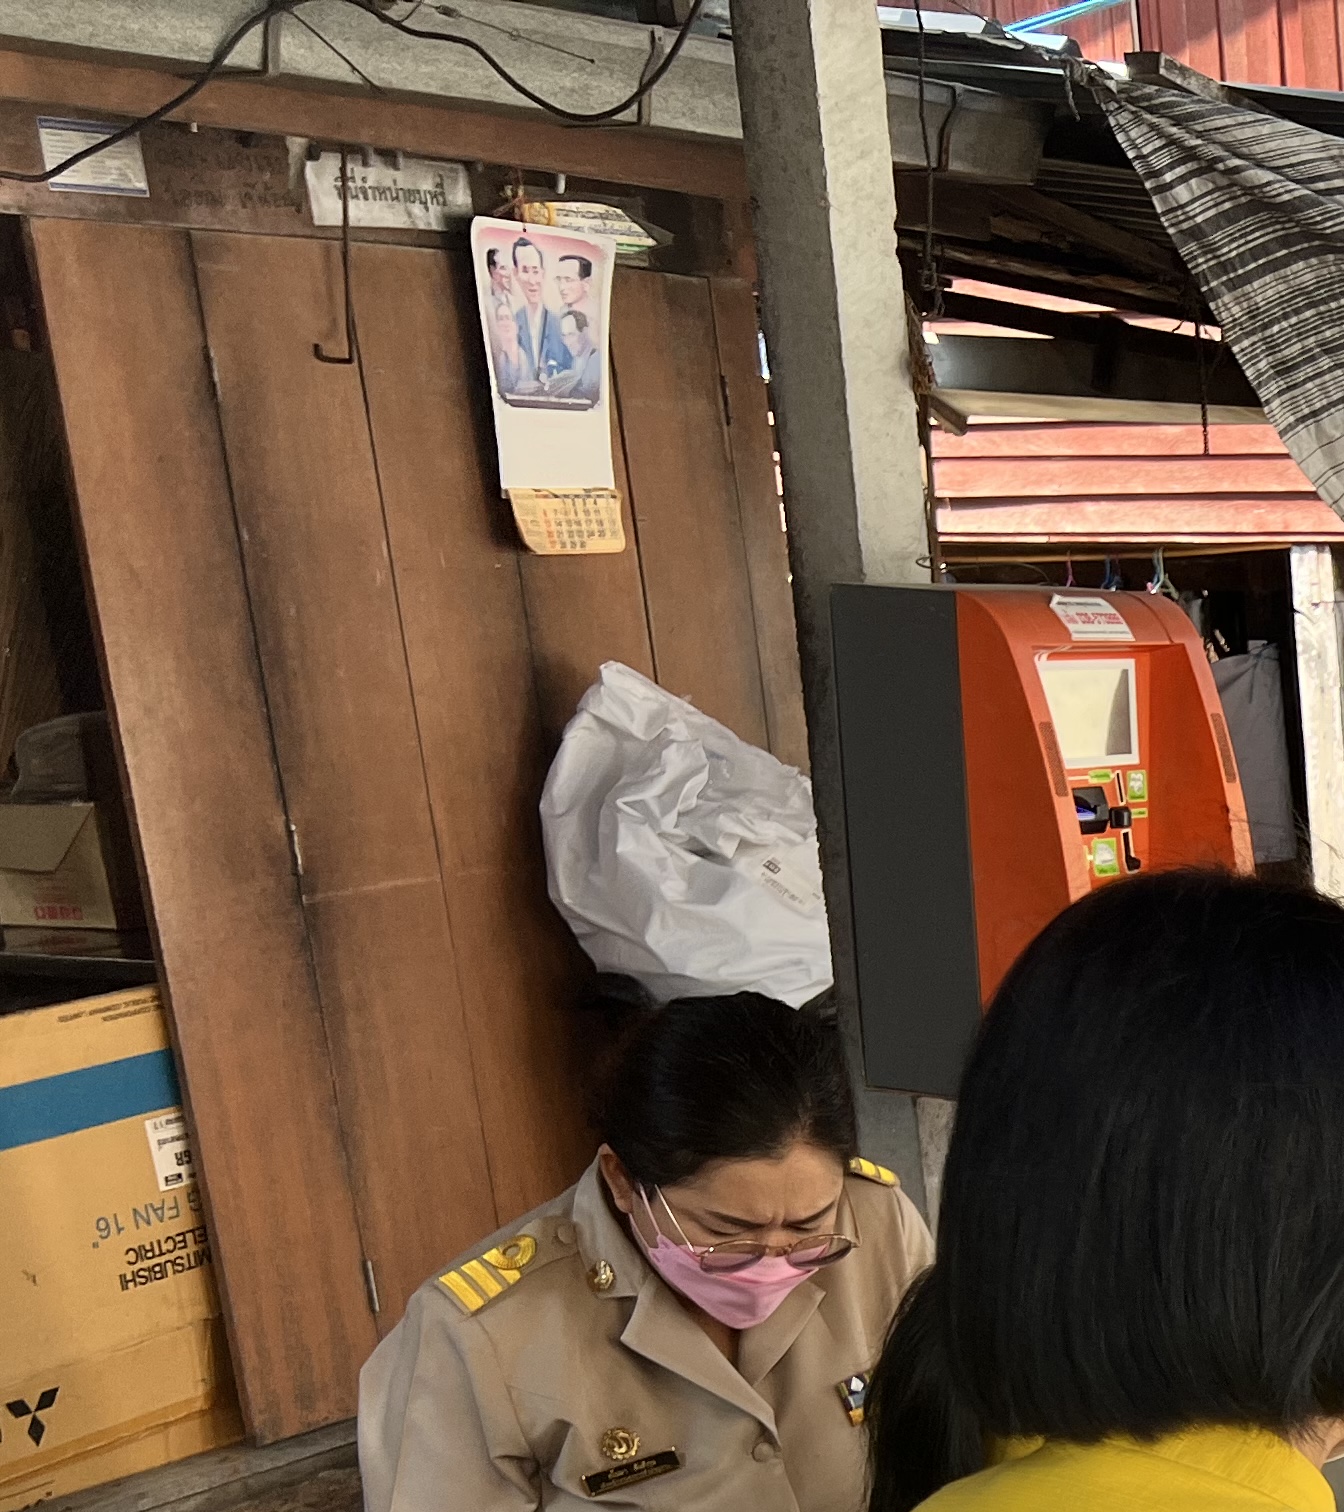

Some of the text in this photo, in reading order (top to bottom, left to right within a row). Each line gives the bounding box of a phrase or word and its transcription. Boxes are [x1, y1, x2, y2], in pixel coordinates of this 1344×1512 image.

[131, 1195, 180, 1231] FAN
[124, 1223, 208, 1266] ELECTRIC
[118, 1245, 212, 1292] MITSUBISHI
